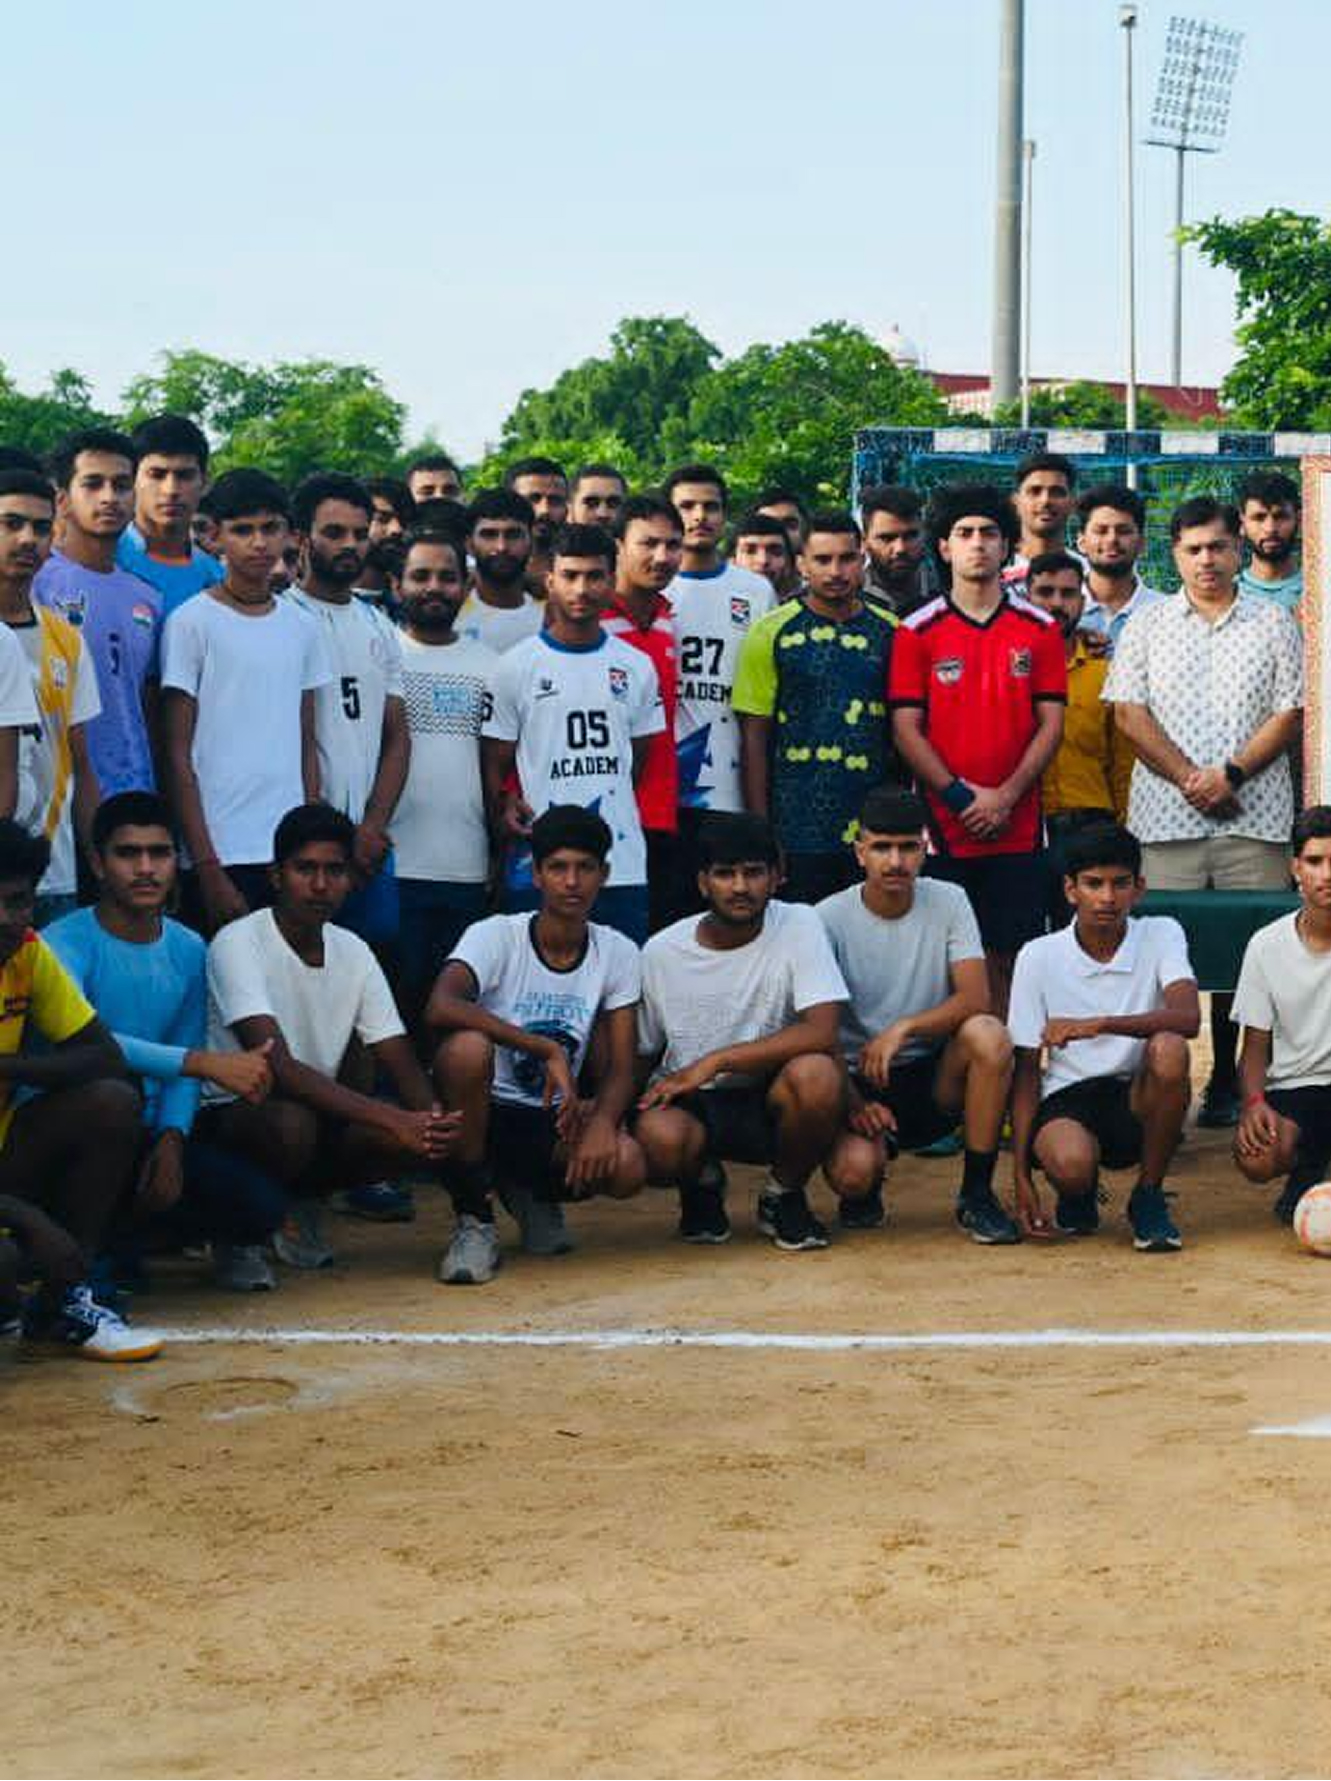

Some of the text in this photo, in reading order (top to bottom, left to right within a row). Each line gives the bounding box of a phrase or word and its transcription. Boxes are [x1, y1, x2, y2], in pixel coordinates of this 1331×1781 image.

[681, 635, 725, 676] 27
[341, 676, 361, 720] 5
[566, 710, 610, 750] 05
